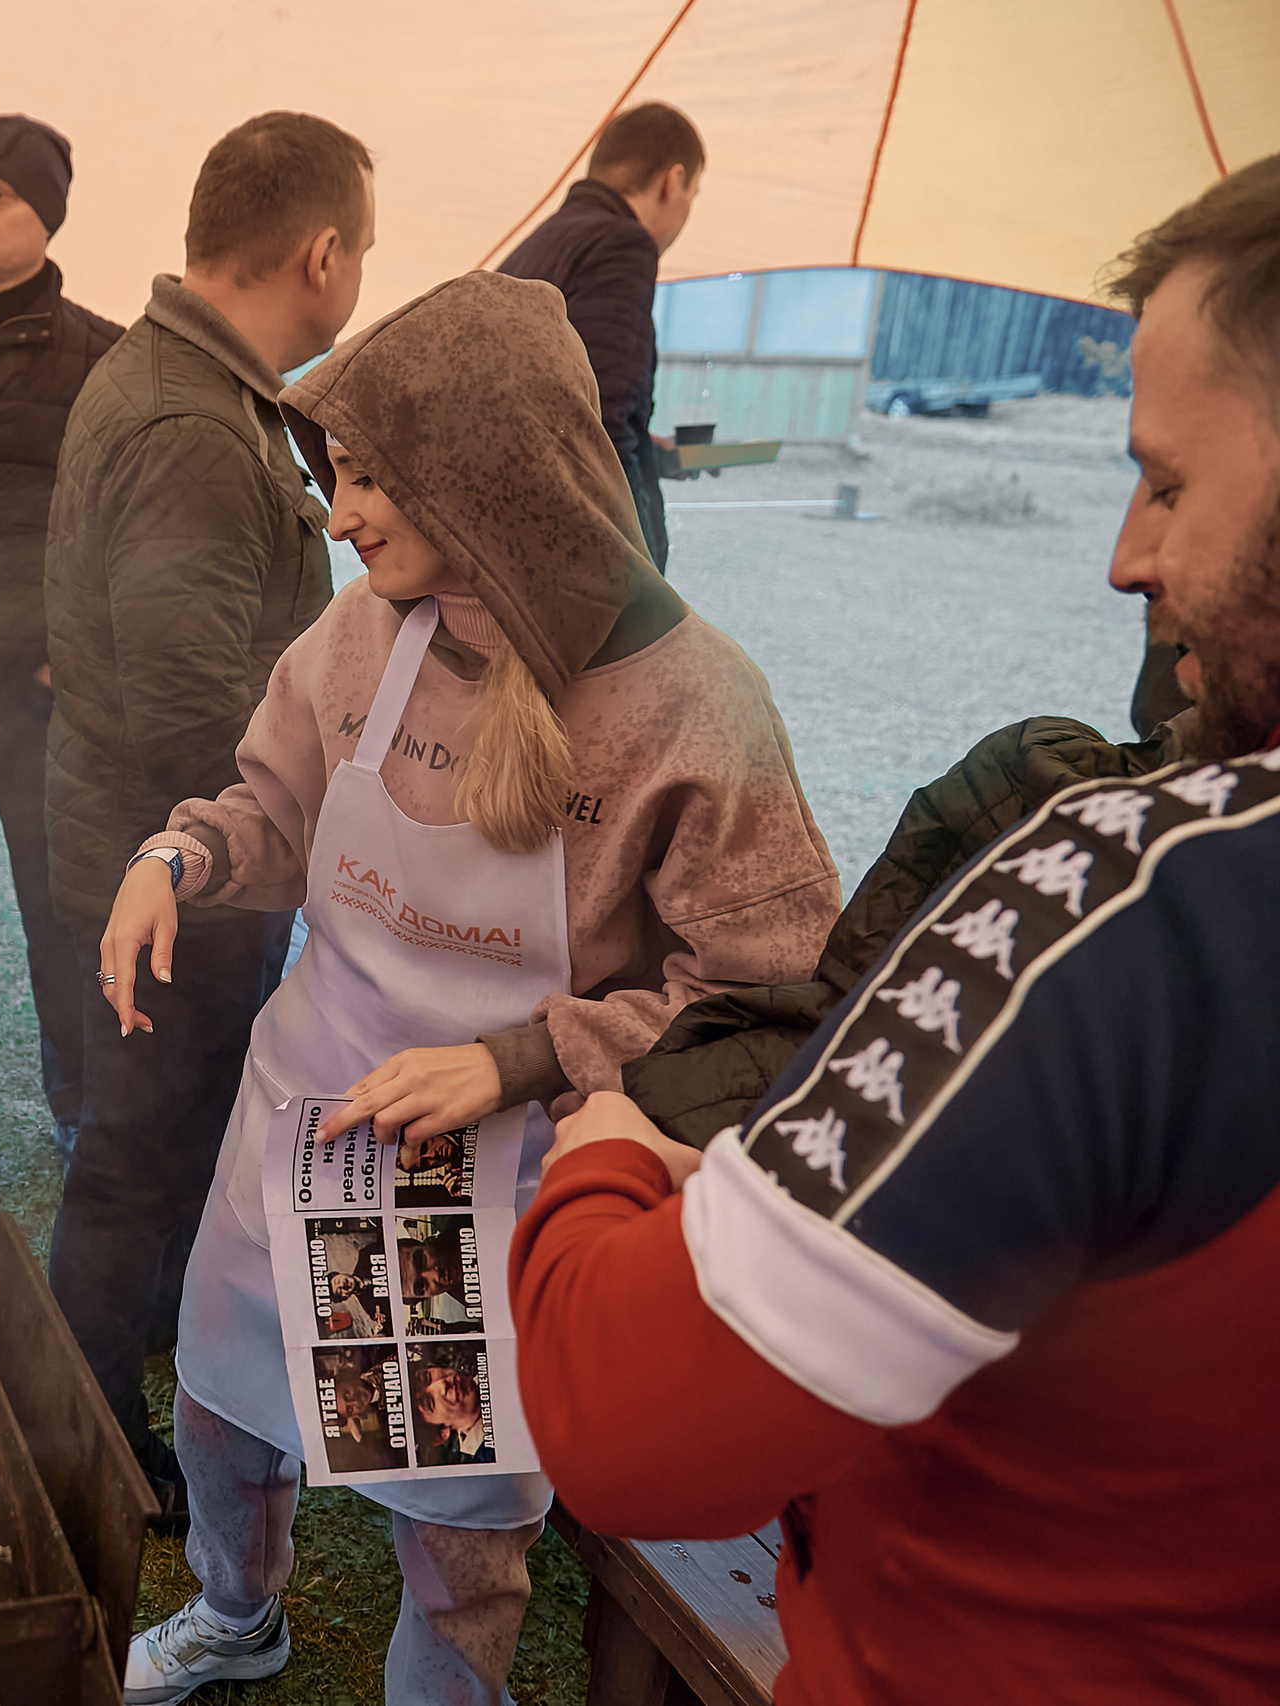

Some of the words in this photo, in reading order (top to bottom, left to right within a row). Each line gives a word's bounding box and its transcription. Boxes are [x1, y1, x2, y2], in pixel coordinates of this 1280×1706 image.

[338, 712, 405, 751] WN
[403, 733, 427, 762] IN
[337, 854, 397, 908] КАК
[399, 902, 521, 947] ДОМА!
[298, 1105, 322, 1204] Основано
[323, 1139, 336, 1164] на
[342, 1125, 359, 1203] реальн
[462, 1157, 475, 1170] ТЕ
[460, 1180, 474, 1197] ДА
[461, 1171, 473, 1179] Я
[310, 1239, 333, 1318] ОТВЕЧАЮ
[370, 1253, 389, 1298] ВАСЯ
[459, 1227, 481, 1305] ОТВЕЧАЮ
[465, 1306, 482, 1319] Я
[476, 1352, 491, 1401] ОТВЕЧАЮ!
[318, 1378, 338, 1422] ТЕБЕ
[382, 1361, 407, 1449] ОТВЕЧАЮ
[480, 1401, 493, 1425] ТЕБЕ
[324, 1425, 341, 1439] Я
[483, 1425, 494, 1433] Я
[484, 1433, 496, 1449] ДА
